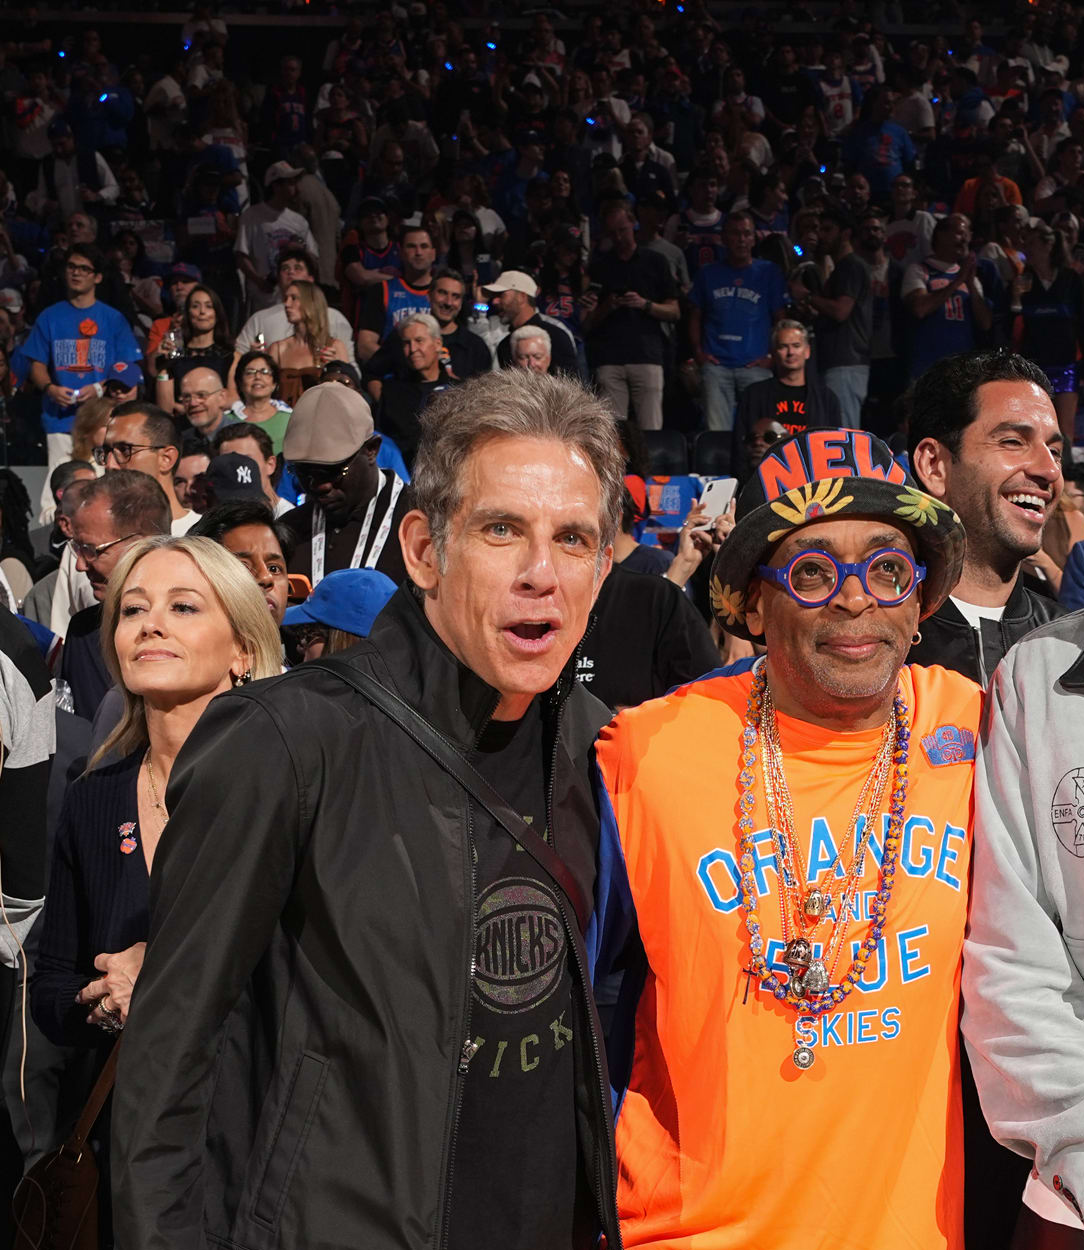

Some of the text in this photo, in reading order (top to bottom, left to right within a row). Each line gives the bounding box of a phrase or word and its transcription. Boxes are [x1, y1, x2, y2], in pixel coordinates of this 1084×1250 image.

[713, 287, 761, 304] NEW YORK
[945, 296, 965, 320] 11
[757, 429, 907, 502] NEW
[696, 813, 966, 914] ORANGE
[822, 890, 880, 924] AND
[476, 914, 560, 978] KNICKS
[794, 1006, 902, 1049] SKIES
